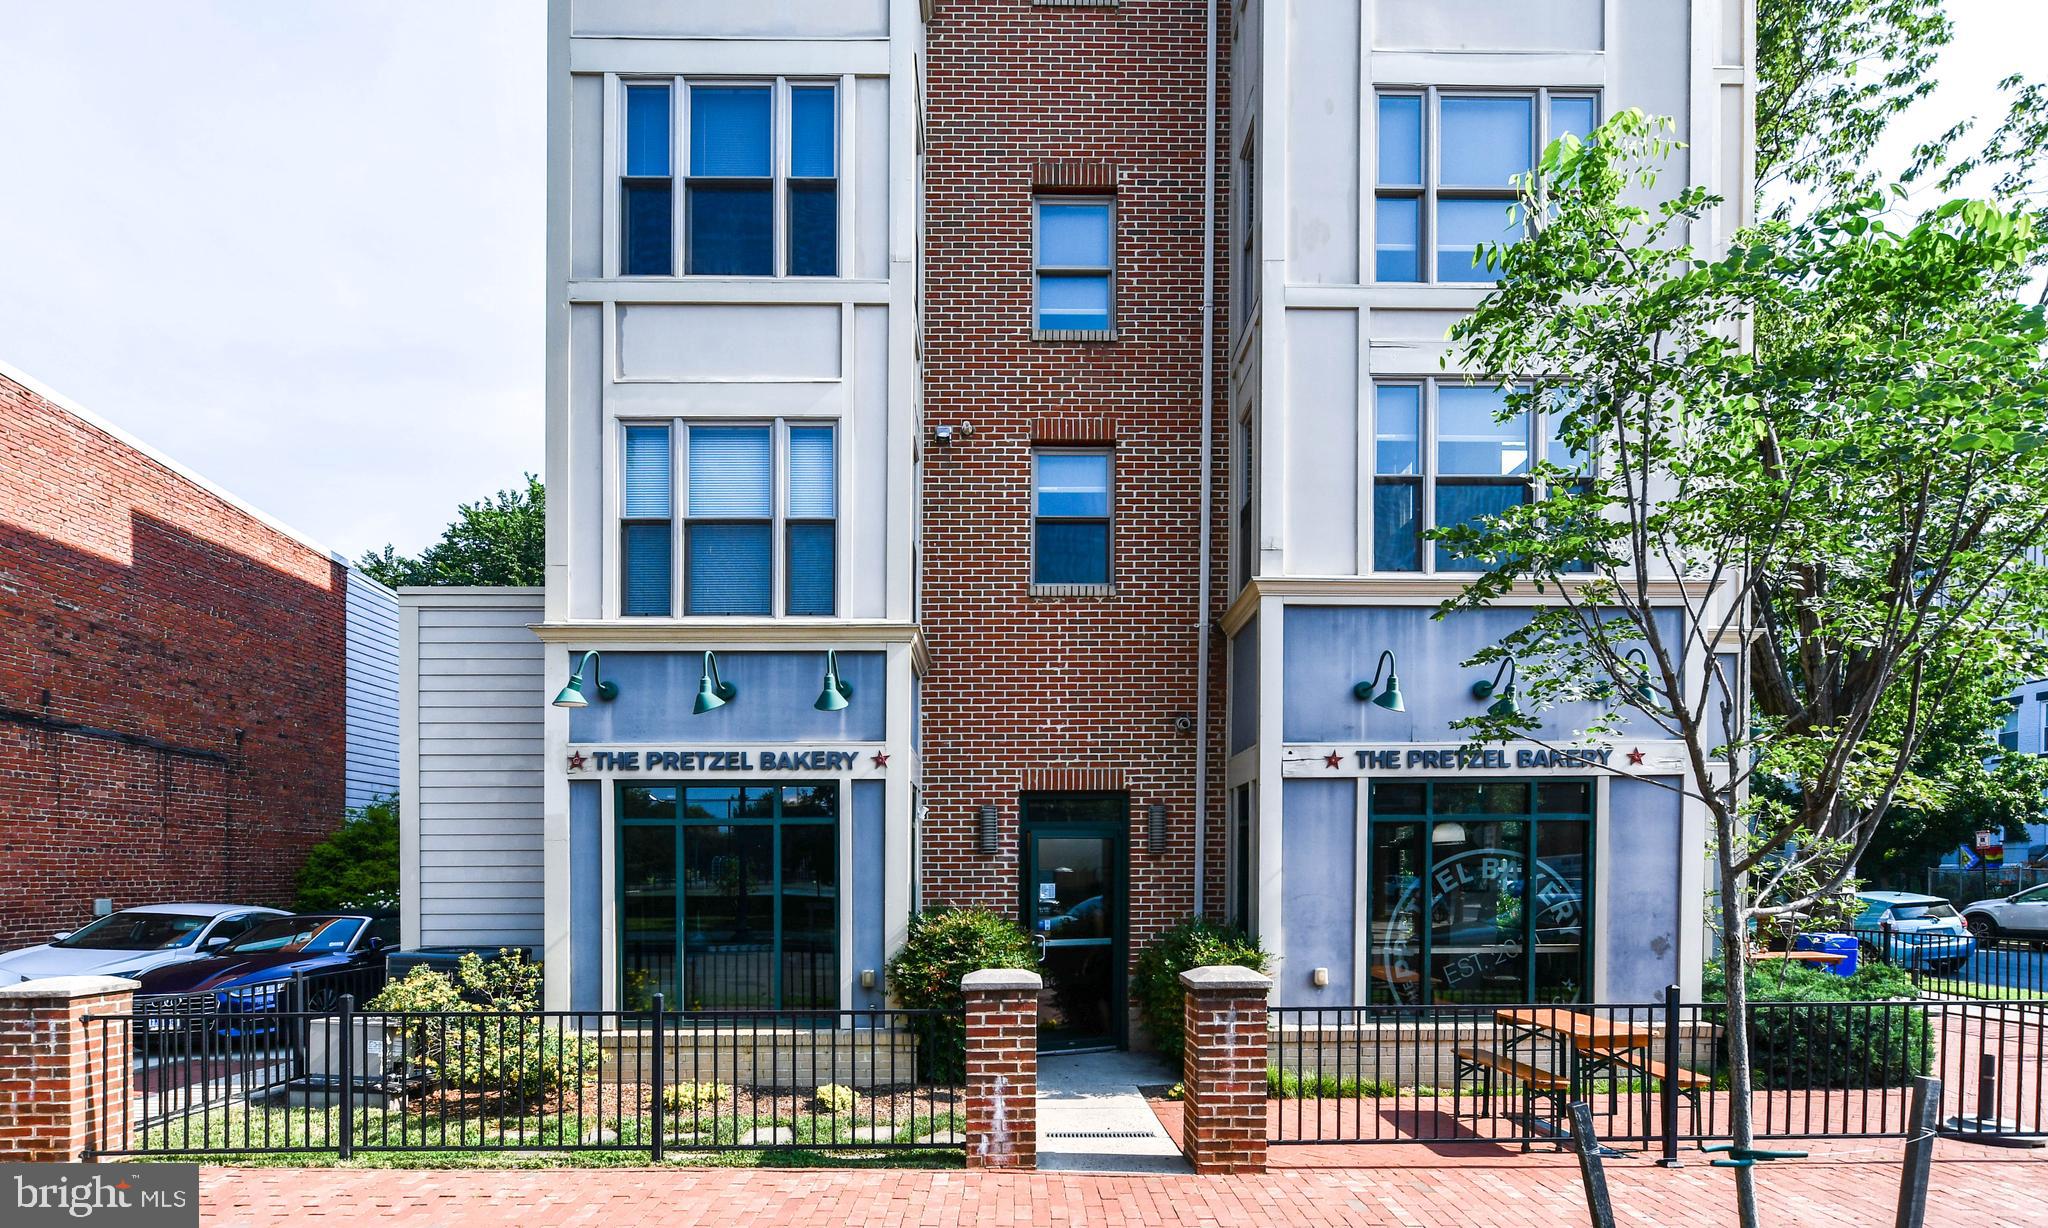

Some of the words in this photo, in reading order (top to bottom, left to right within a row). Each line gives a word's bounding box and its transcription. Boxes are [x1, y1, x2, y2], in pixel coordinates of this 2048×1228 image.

[593, 751, 640, 771] THE
[647, 751, 753, 771] PRETZEL
[760, 750, 859, 771] BAKERY
[1355, 750, 1401, 770] THE
[1407, 750, 1511, 769] PRETZEL
[1517, 749, 1613, 768] BAKERY
[1482, 857, 1582, 935] BAERY
[1443, 953, 1488, 985] EST.
